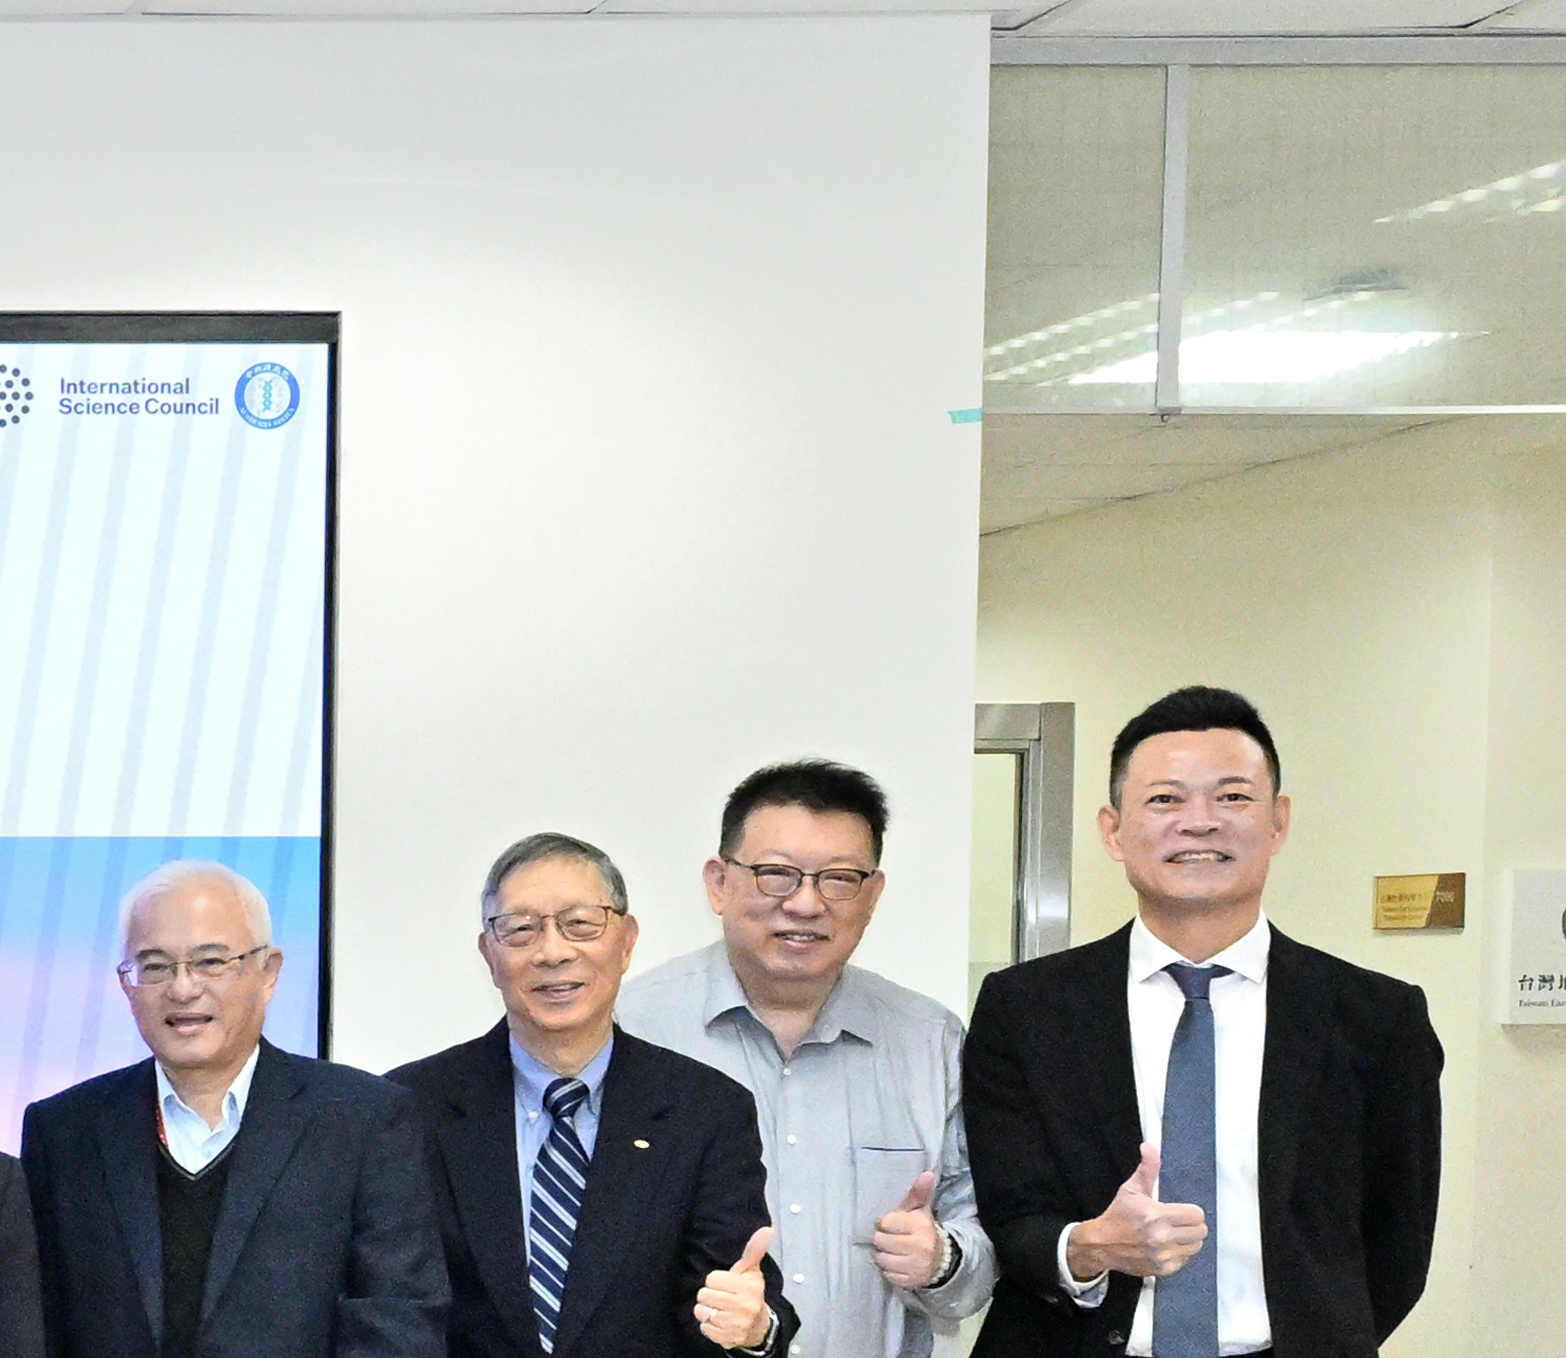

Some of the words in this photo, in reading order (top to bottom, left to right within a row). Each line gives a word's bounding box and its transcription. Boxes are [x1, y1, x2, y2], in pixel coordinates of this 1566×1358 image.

[60, 377, 190, 394] International
[59, 397, 140, 415] Science
[144, 397, 219, 415] Council
